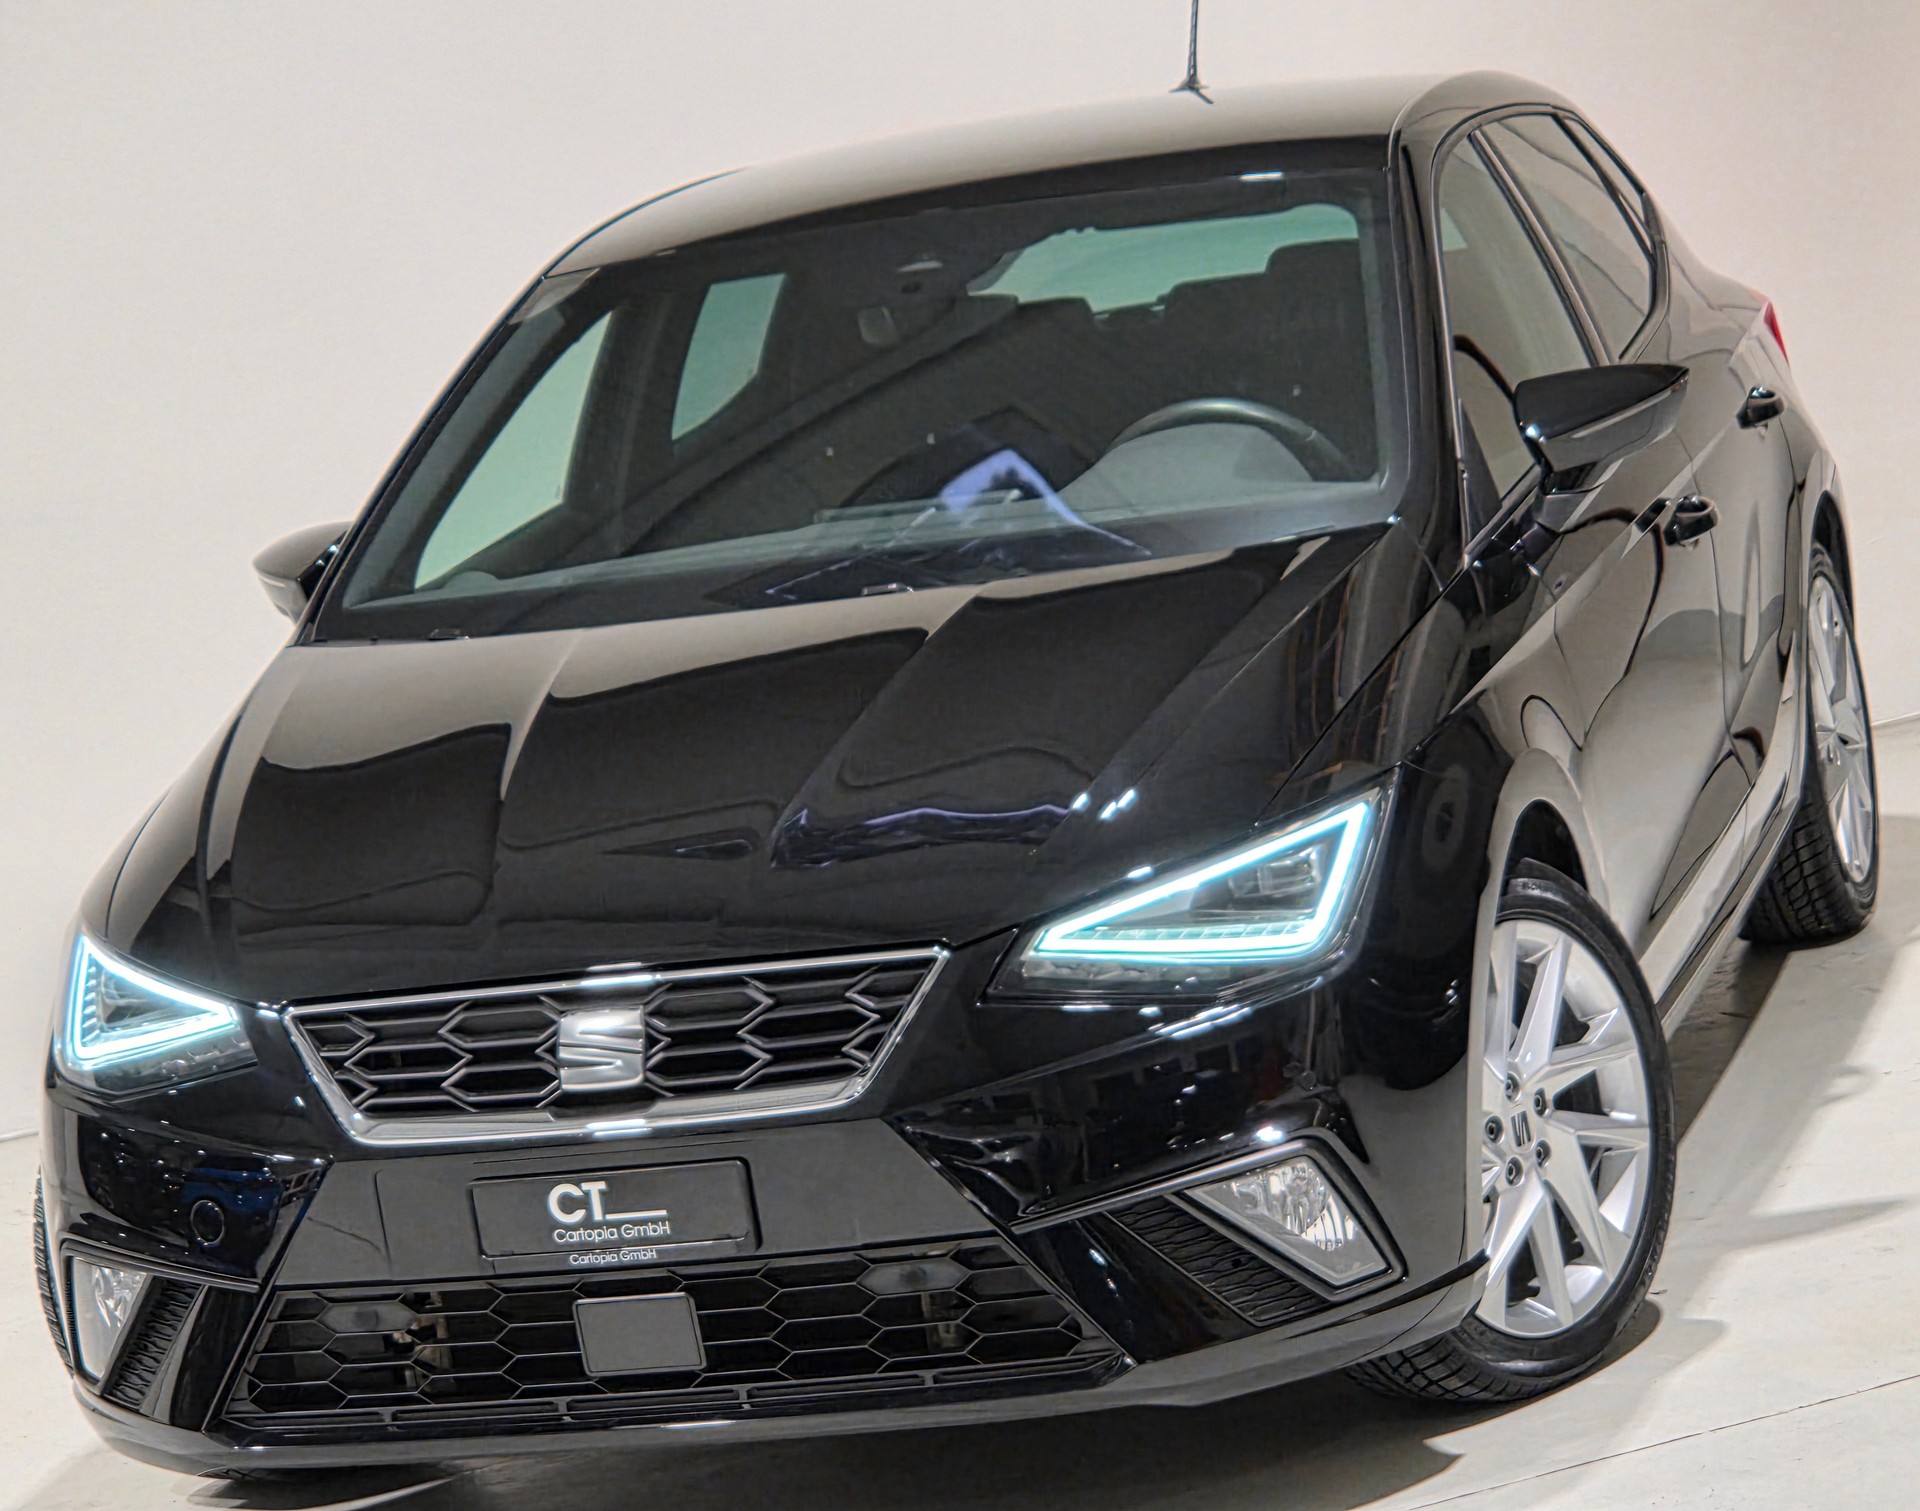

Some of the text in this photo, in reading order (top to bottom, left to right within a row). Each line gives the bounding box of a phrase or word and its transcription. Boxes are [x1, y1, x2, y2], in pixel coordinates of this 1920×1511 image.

[554, 1221, 670, 1242] Cartopia GmbH
[570, 1249, 657, 1264] Cartopia GmbH
